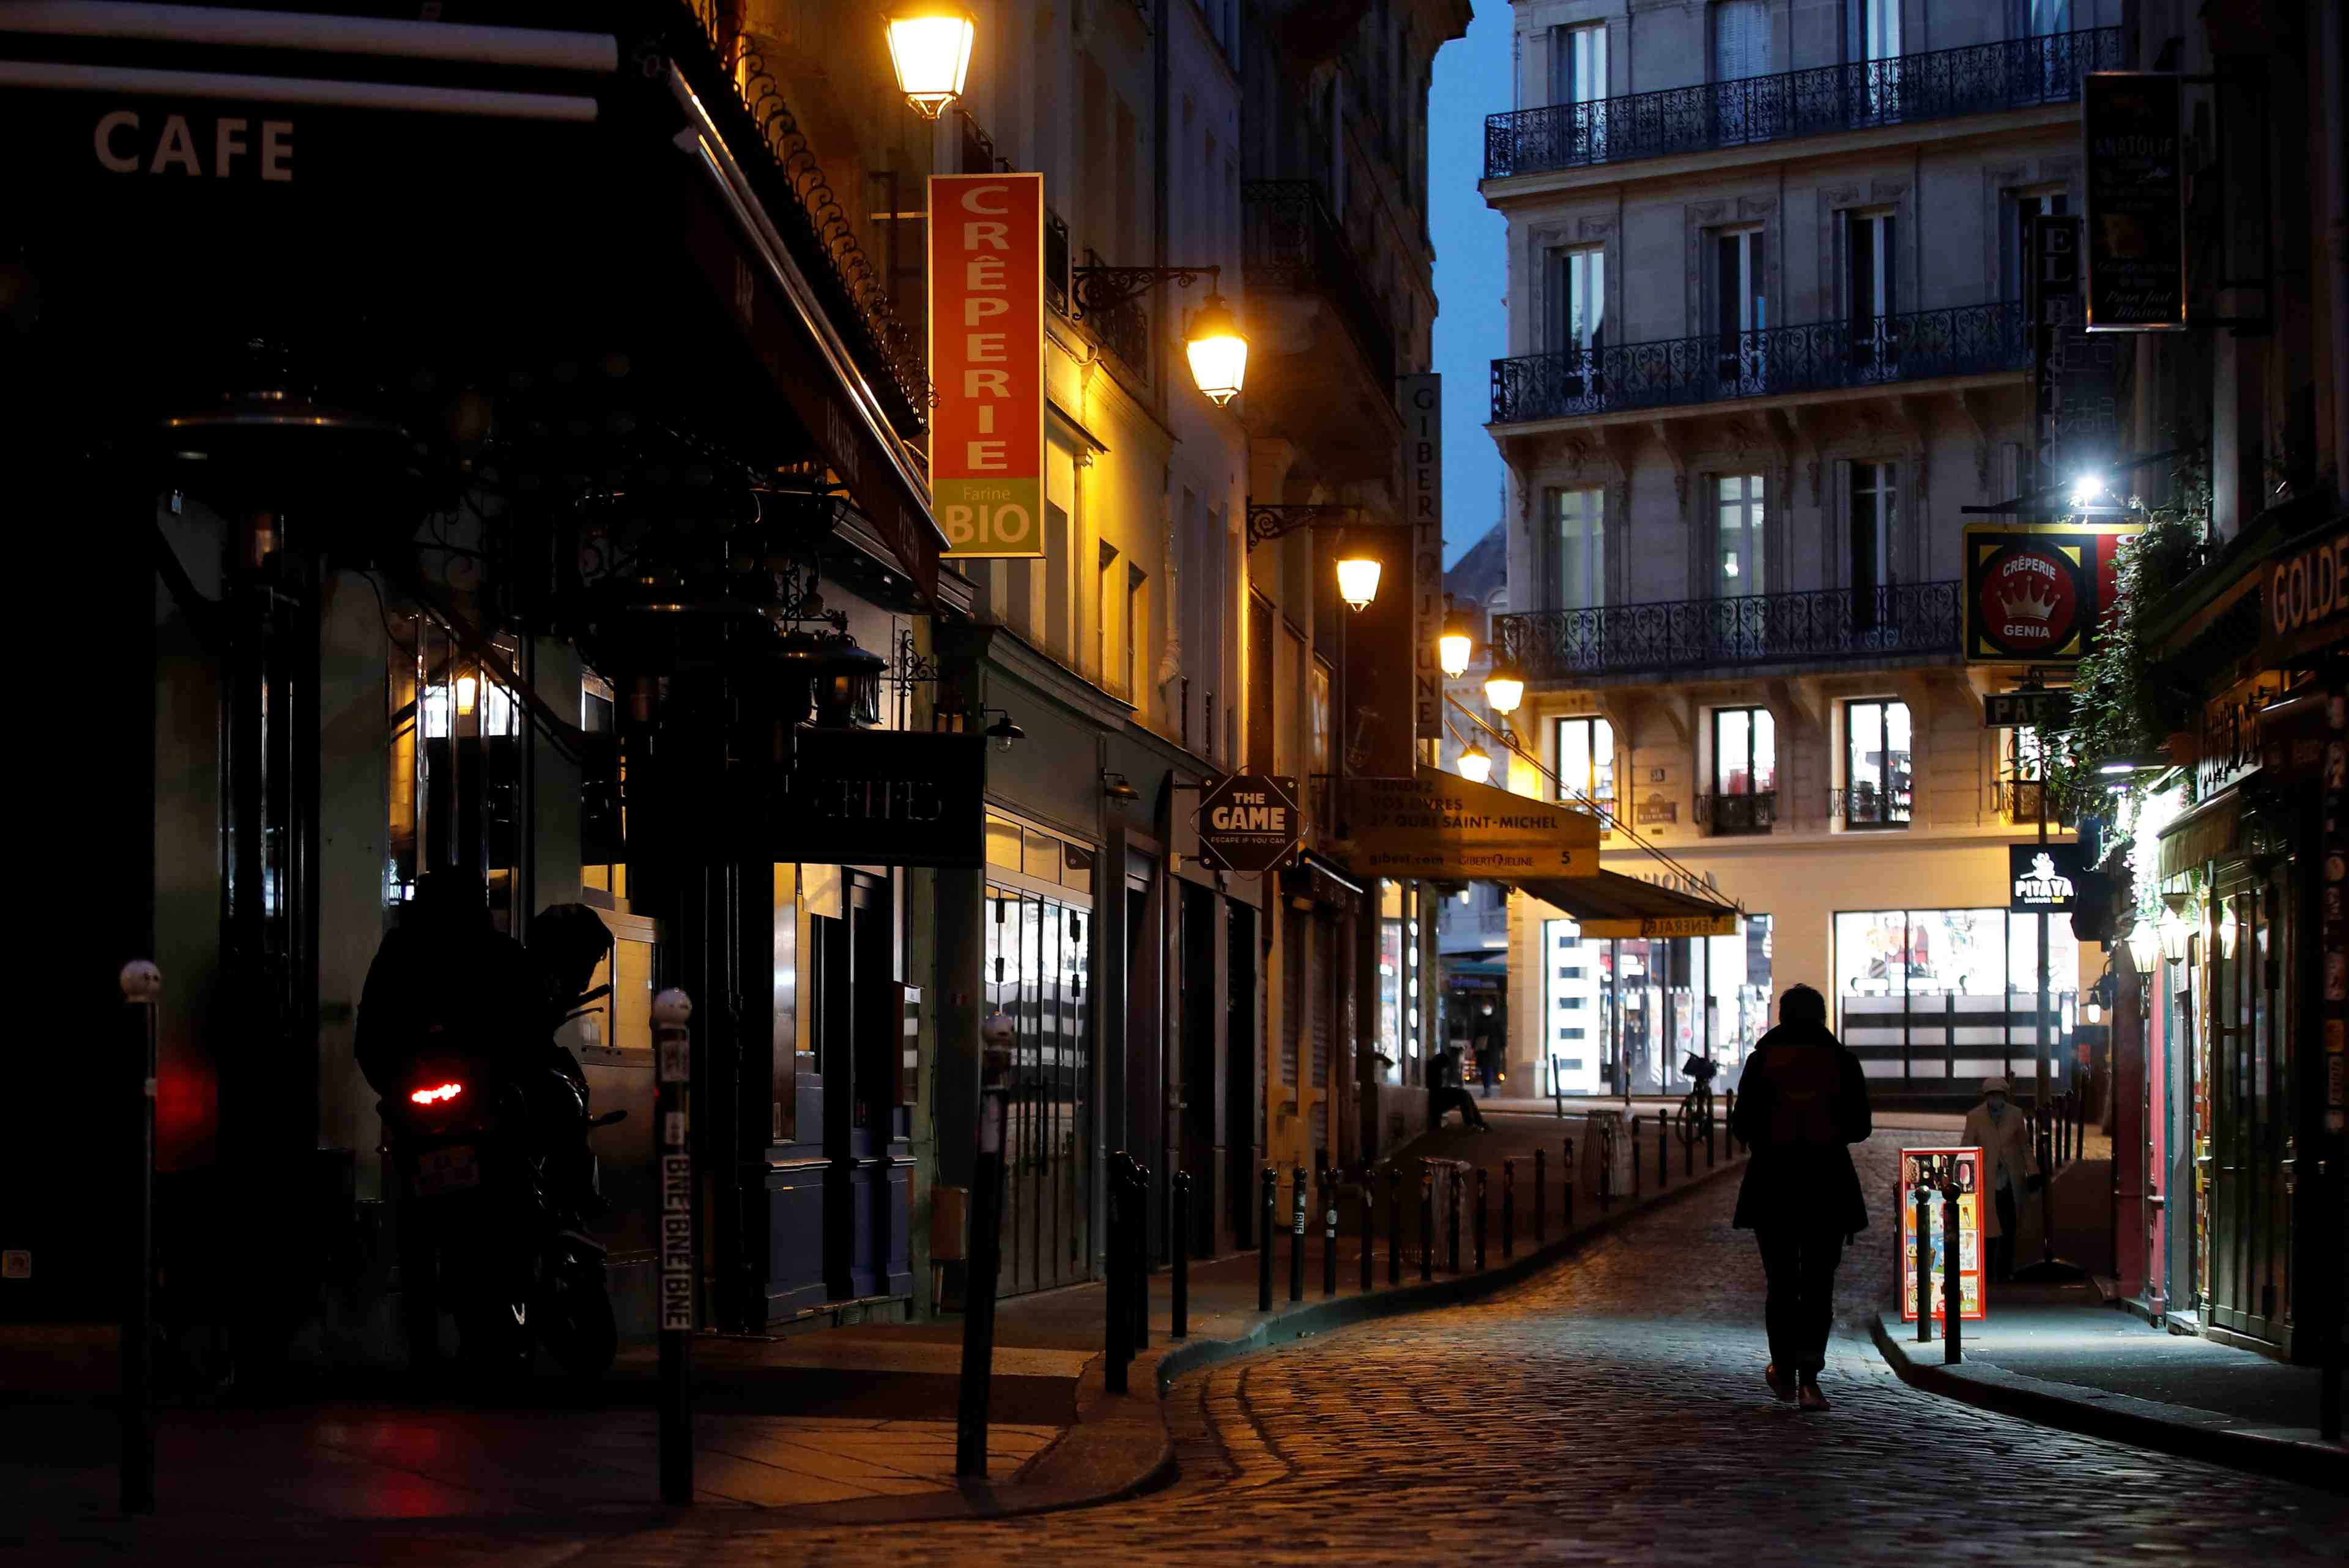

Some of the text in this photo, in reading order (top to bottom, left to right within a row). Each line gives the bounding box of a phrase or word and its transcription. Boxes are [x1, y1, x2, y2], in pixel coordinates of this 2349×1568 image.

[93, 109, 294, 183] CAFE
[960, 185, 1012, 470] CRÊPERIE
[1414, 388, 1435, 544] GIBERT
[963, 486, 1011, 501] Farine
[945, 503, 1030, 544] BIO
[2002, 555, 2057, 581] CRÊPERIE
[2272, 531, 2349, 636] GOLDE
[2002, 623, 2051, 639] GENIA
[1417, 593, 1436, 725] JEUNE
[1233, 792, 1265, 804] THE
[1212, 806, 1285, 830] GAME
[1442, 816, 1559, 830] SAINT-MICHEL
[1560, 850, 1572, 864] 5
[2015, 880, 2074, 897] PITAYA
